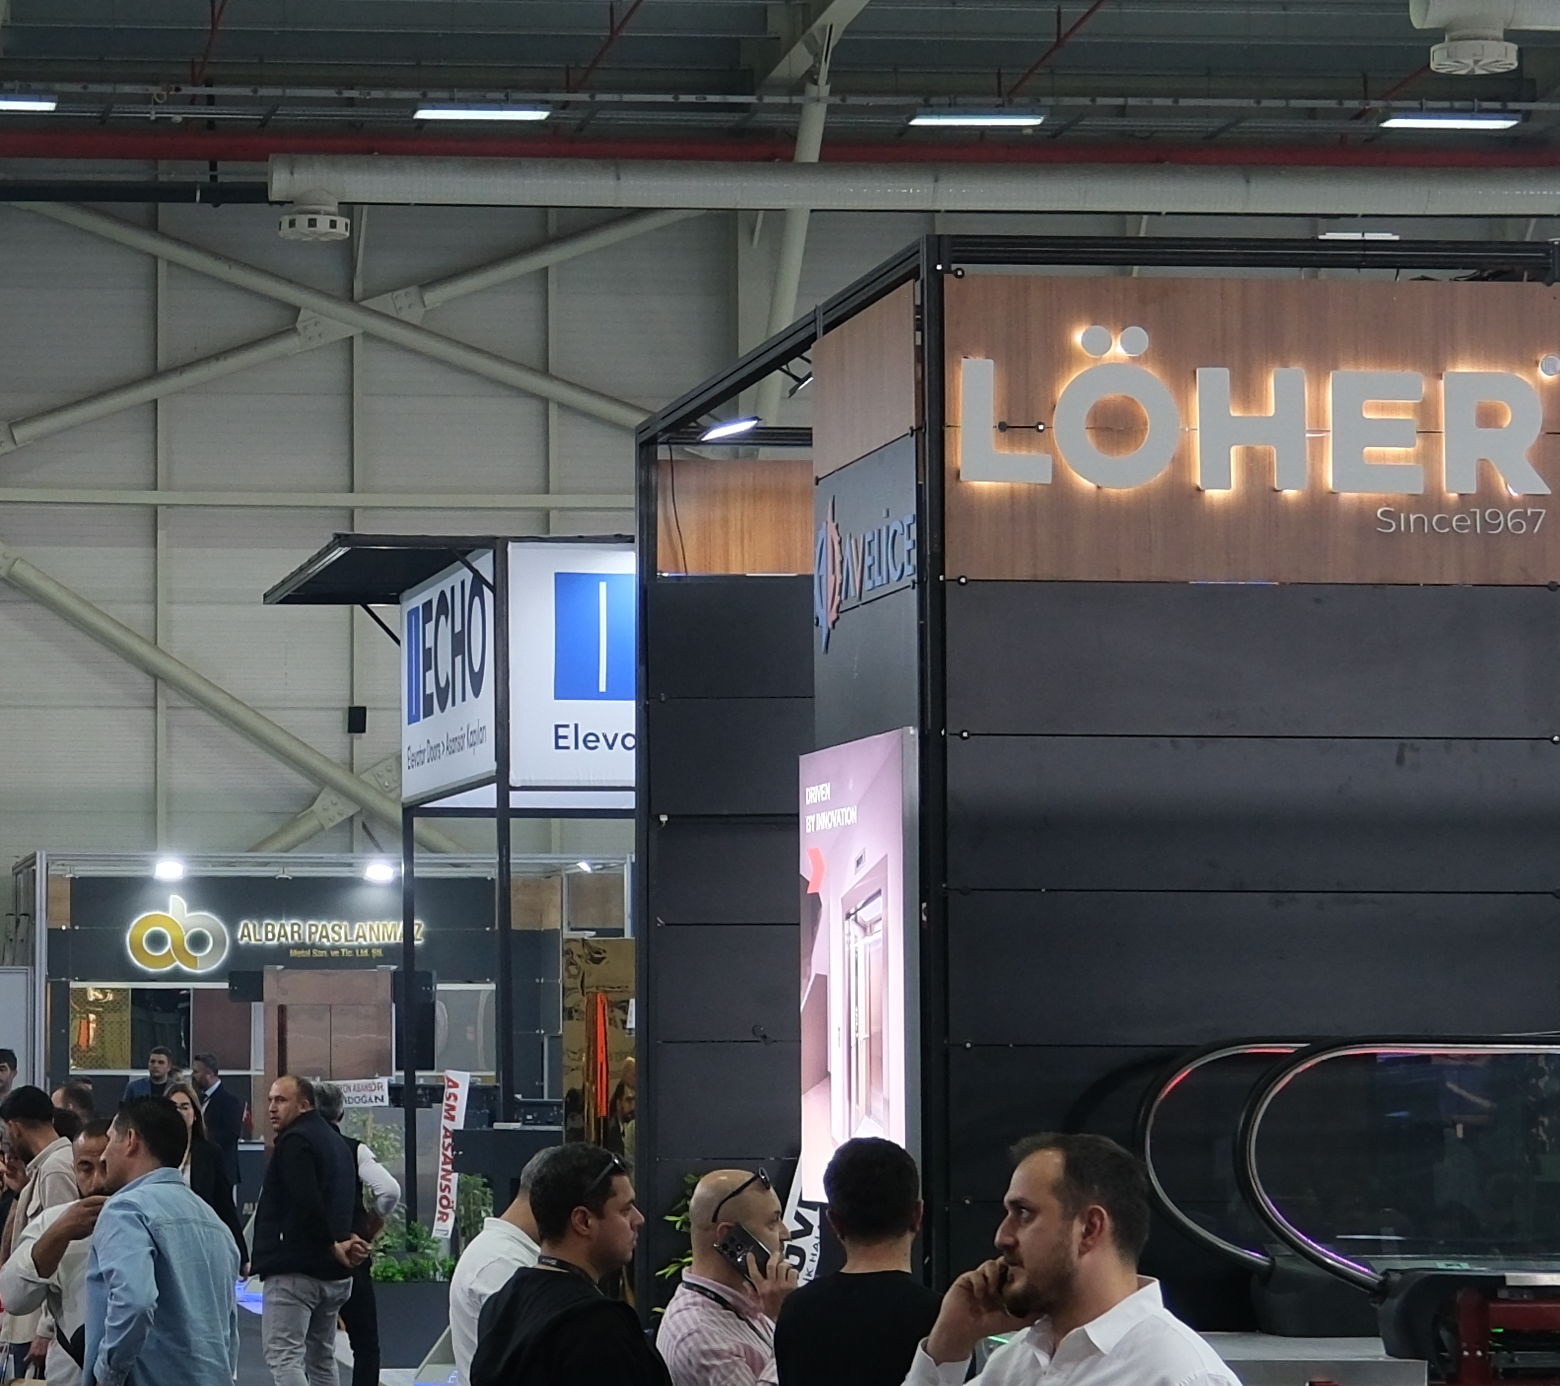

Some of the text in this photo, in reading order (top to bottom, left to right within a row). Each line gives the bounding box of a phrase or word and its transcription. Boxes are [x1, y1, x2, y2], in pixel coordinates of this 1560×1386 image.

[959, 324, 1553, 496] LÖHER
[805, 782, 831, 805] DRIVEN
[805, 805, 858, 833] BY INNOVATION
[238, 922, 302, 943] ALBAR
[443, 1075, 460, 1123] ASM
[436, 1125, 456, 1224] ASANSÖR
